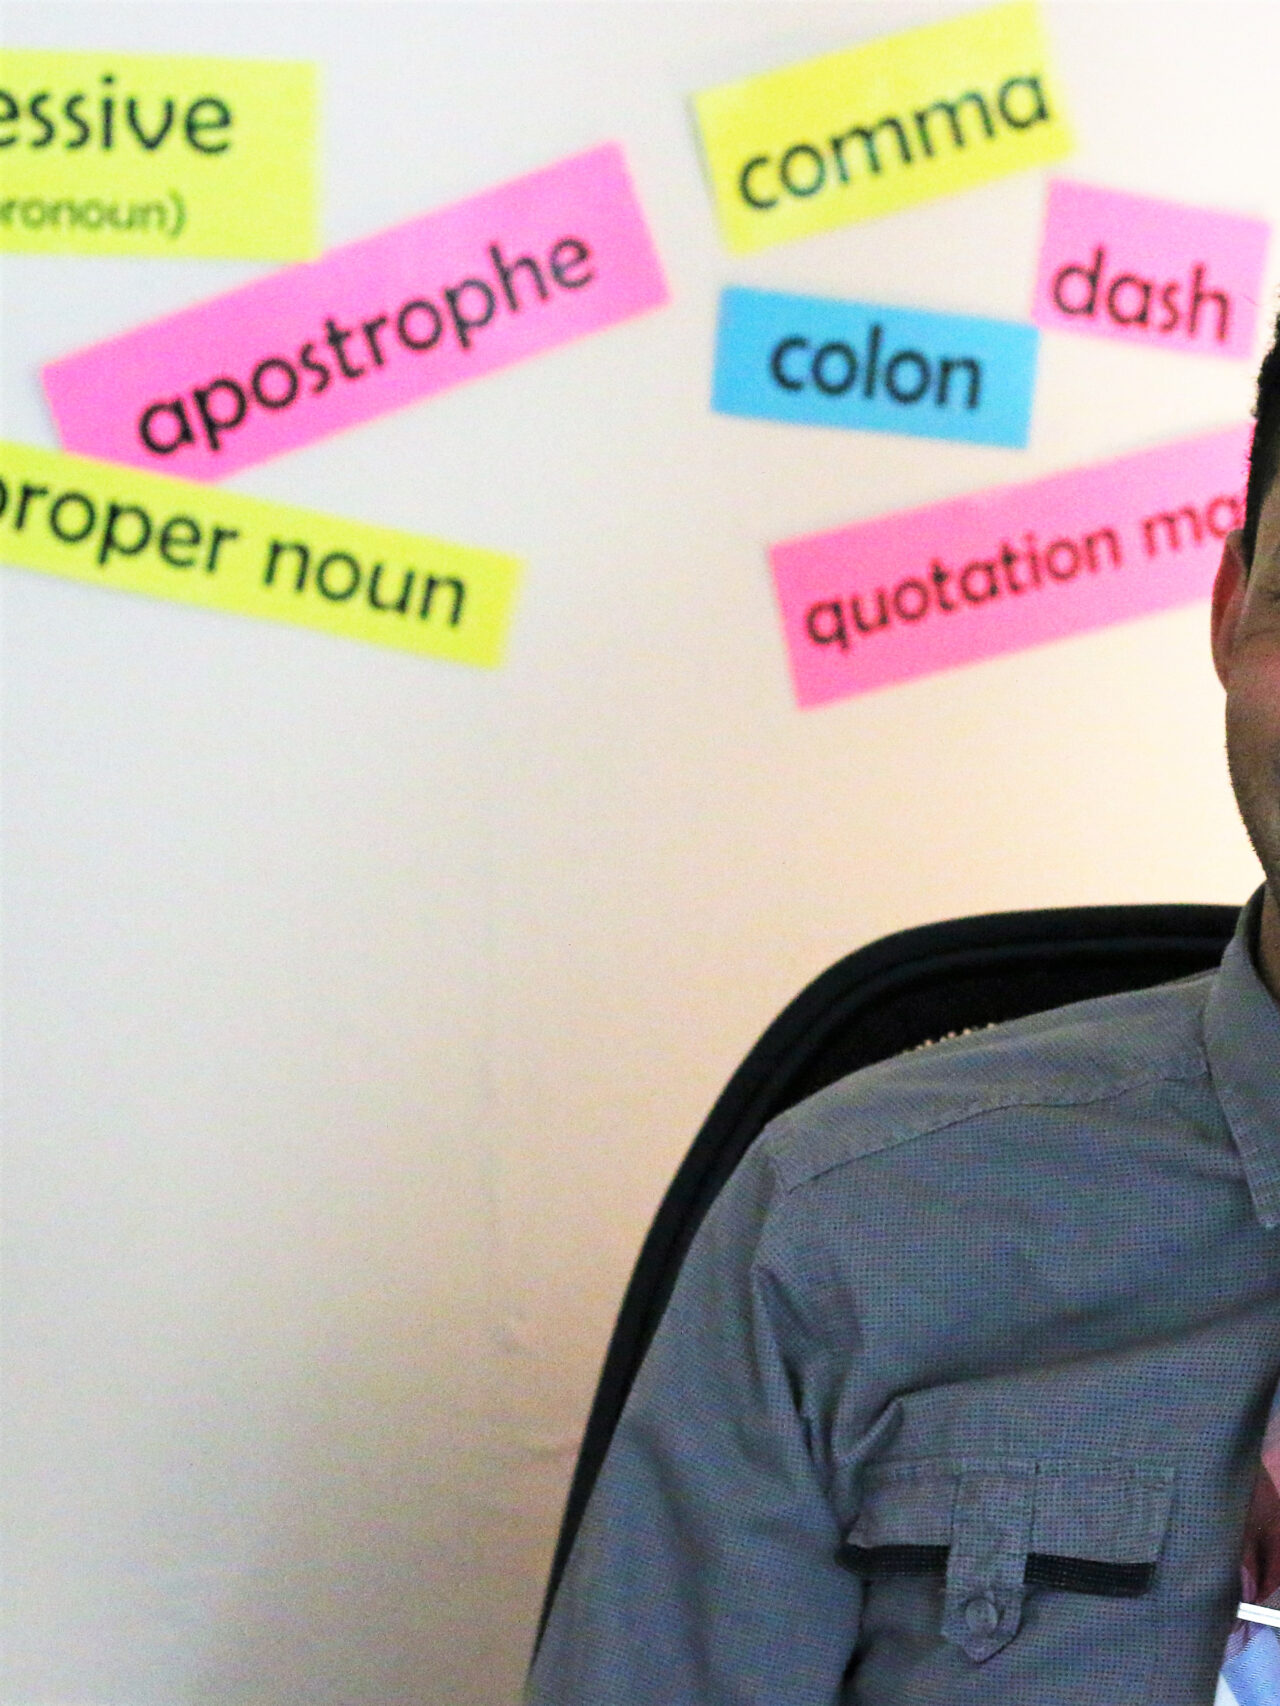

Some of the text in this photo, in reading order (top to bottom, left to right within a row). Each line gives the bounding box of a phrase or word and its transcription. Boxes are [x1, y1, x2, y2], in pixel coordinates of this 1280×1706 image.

[736, 74, 1051, 213] comma
[0, 189, 187, 240] ronoun)
[136, 236, 595, 456] apostrophe
[1049, 242, 1233, 344] dash
[768, 322, 983, 411] colon
[0, 476, 467, 629] roper noun
[804, 528, 1124, 652] quotation
